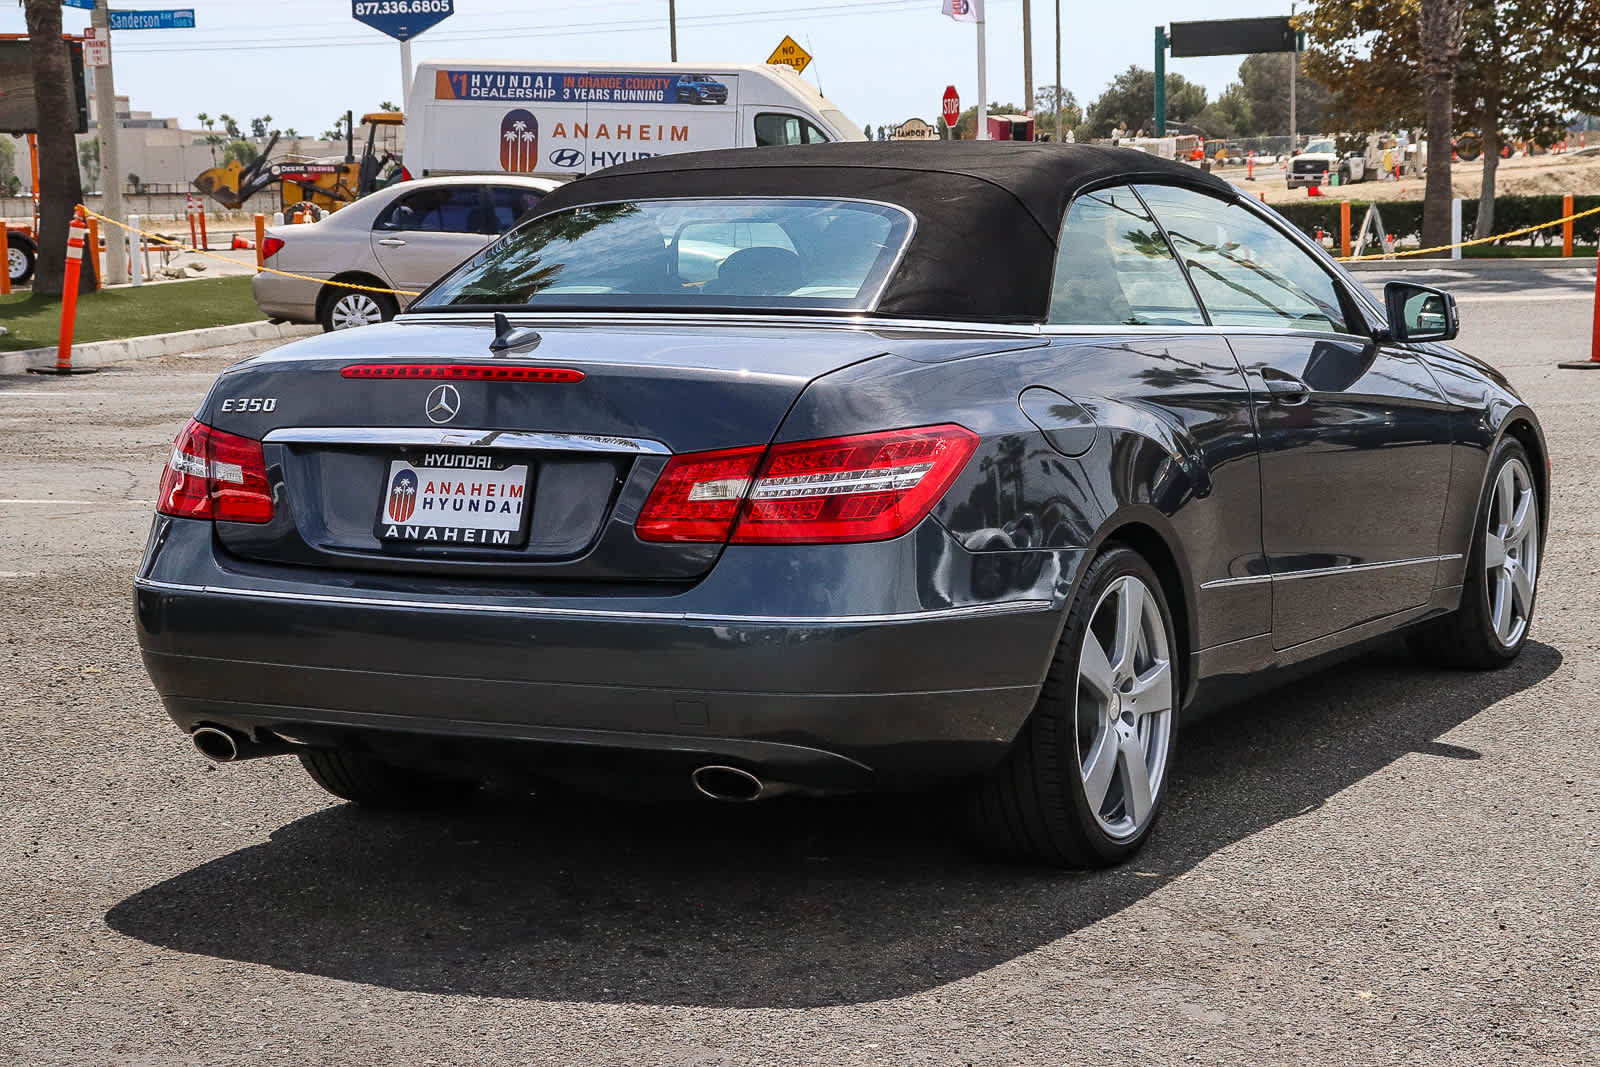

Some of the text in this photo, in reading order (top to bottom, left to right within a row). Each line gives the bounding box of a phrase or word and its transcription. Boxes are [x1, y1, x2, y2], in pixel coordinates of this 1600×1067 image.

[355, 0, 450, 15] 877.336.6805
[111, 12, 160, 29] Sanderson
[782, 46, 795, 55] NO
[471, 75, 553, 89] HYUNDAI
[563, 77, 671, 90] IN ORANGE COUNTY
[470, 87, 556, 99] DEALERSHIP
[563, 88, 664, 101] 3 YEARS RUNNING
[943, 98, 959, 115] STOP
[551, 122, 689, 142] ANAHEIM
[281, 161, 305, 172] DEERE
[424, 453, 493, 469] HYUNDAI
[424, 481, 524, 498] ANAHEIM
[422, 497, 522, 514] HYUNDAI
[384, 524, 511, 545] ANAHEIM
